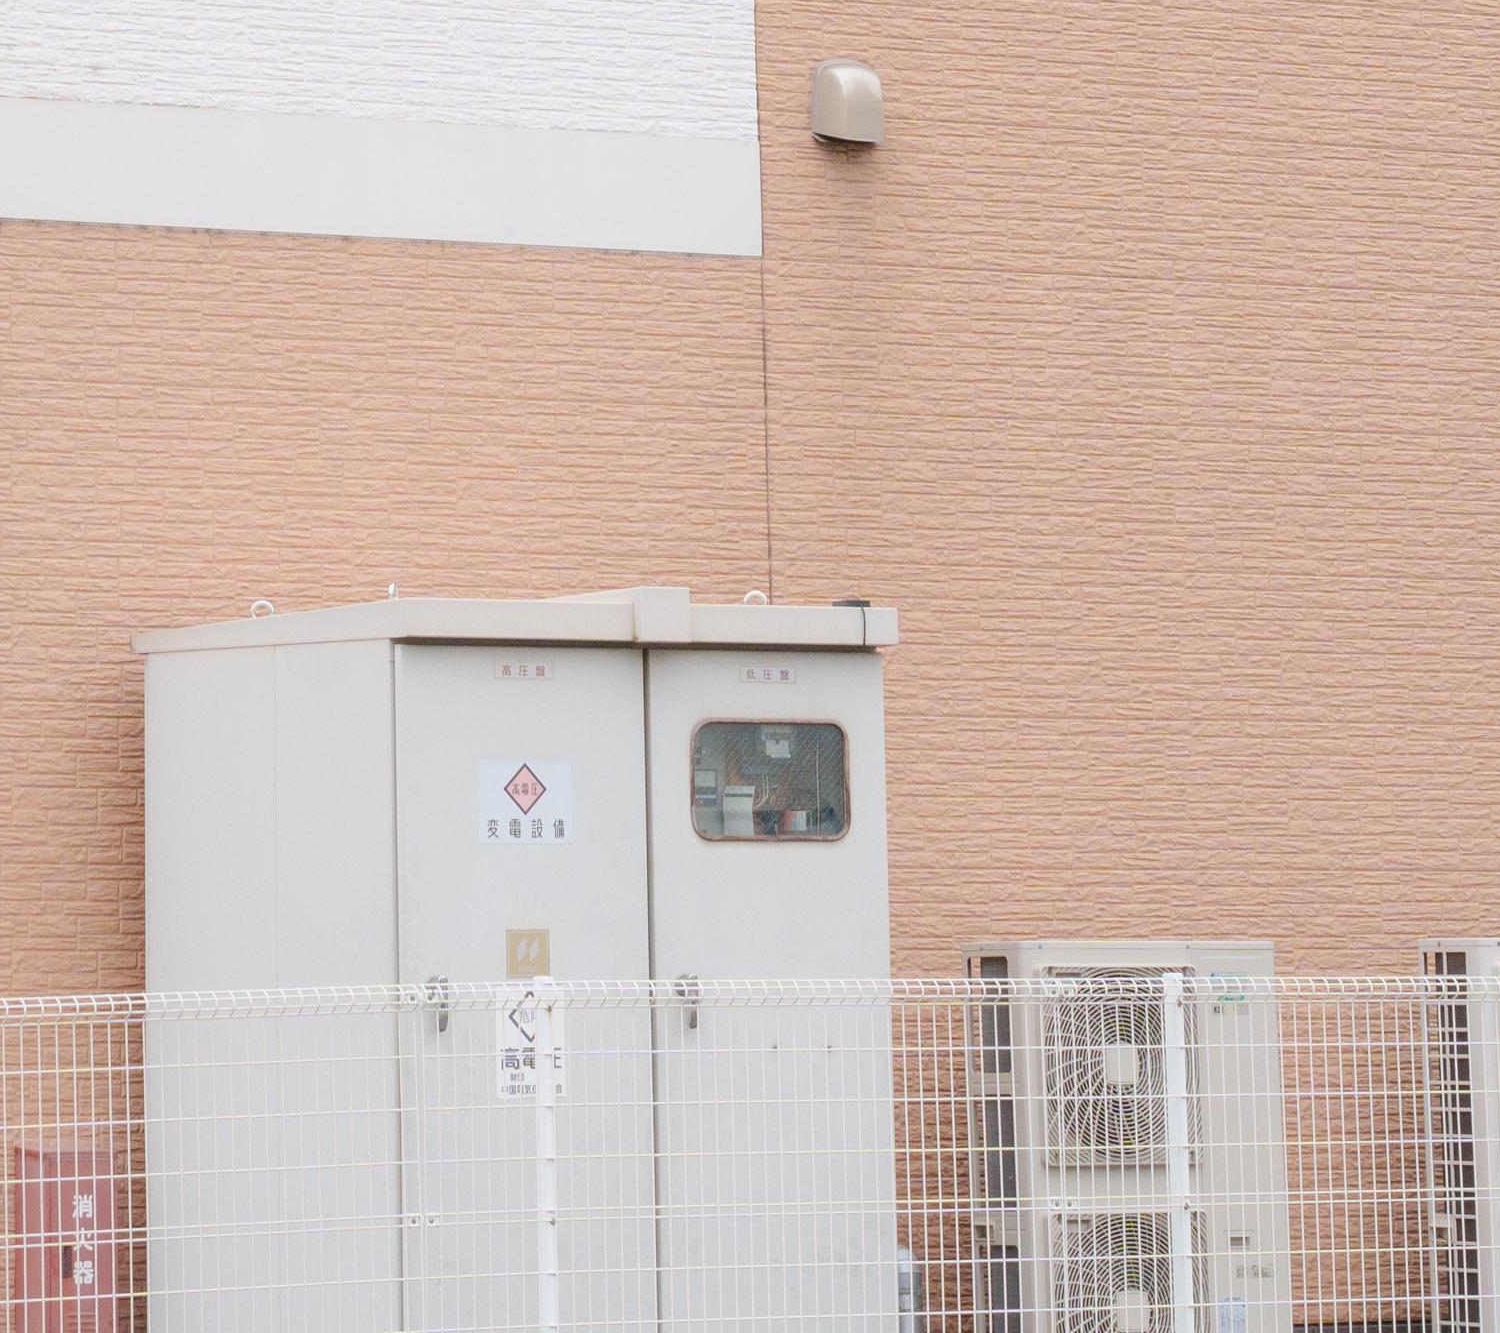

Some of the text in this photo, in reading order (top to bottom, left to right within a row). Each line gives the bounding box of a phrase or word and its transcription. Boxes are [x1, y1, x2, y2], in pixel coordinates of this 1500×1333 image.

[501, 664, 546, 678] 高圧盤
[746, 668, 790, 681] 低圧盤
[511, 782, 539, 797] 高電圧
[486, 817, 565, 839] 変電設備
[71, 1193, 95, 1285] 消火器
